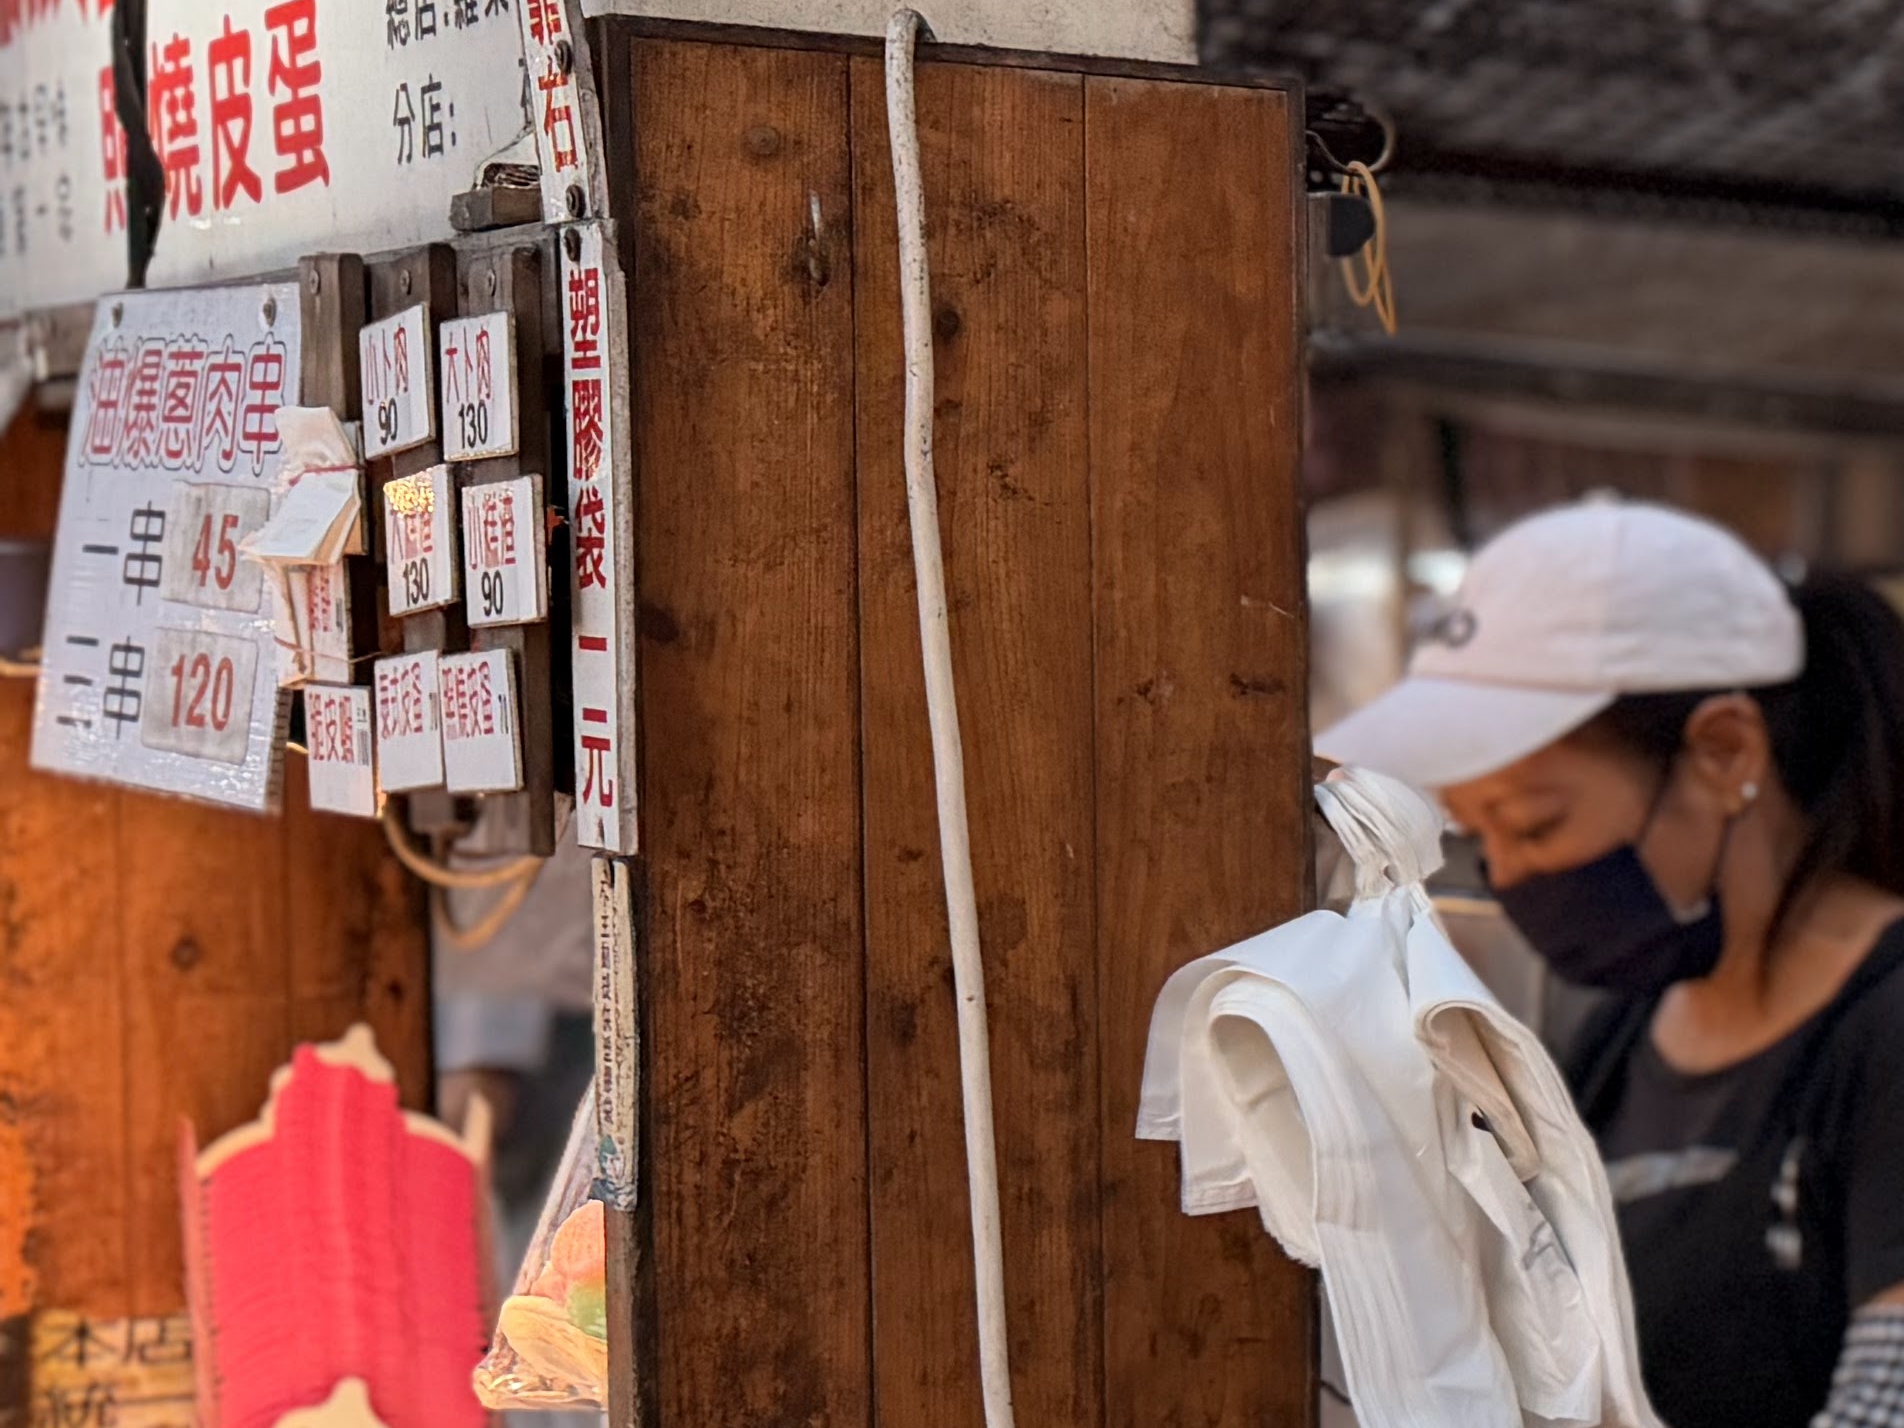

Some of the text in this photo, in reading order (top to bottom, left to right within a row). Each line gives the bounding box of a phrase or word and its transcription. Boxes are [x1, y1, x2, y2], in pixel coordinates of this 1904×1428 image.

[377, 396, 400, 448] 90
[457, 398, 490, 451] 130
[192, 512, 240, 592] 45
[402, 557, 432, 608] 130
[480, 570, 505, 618] 90
[170, 652, 236, 734] 120
